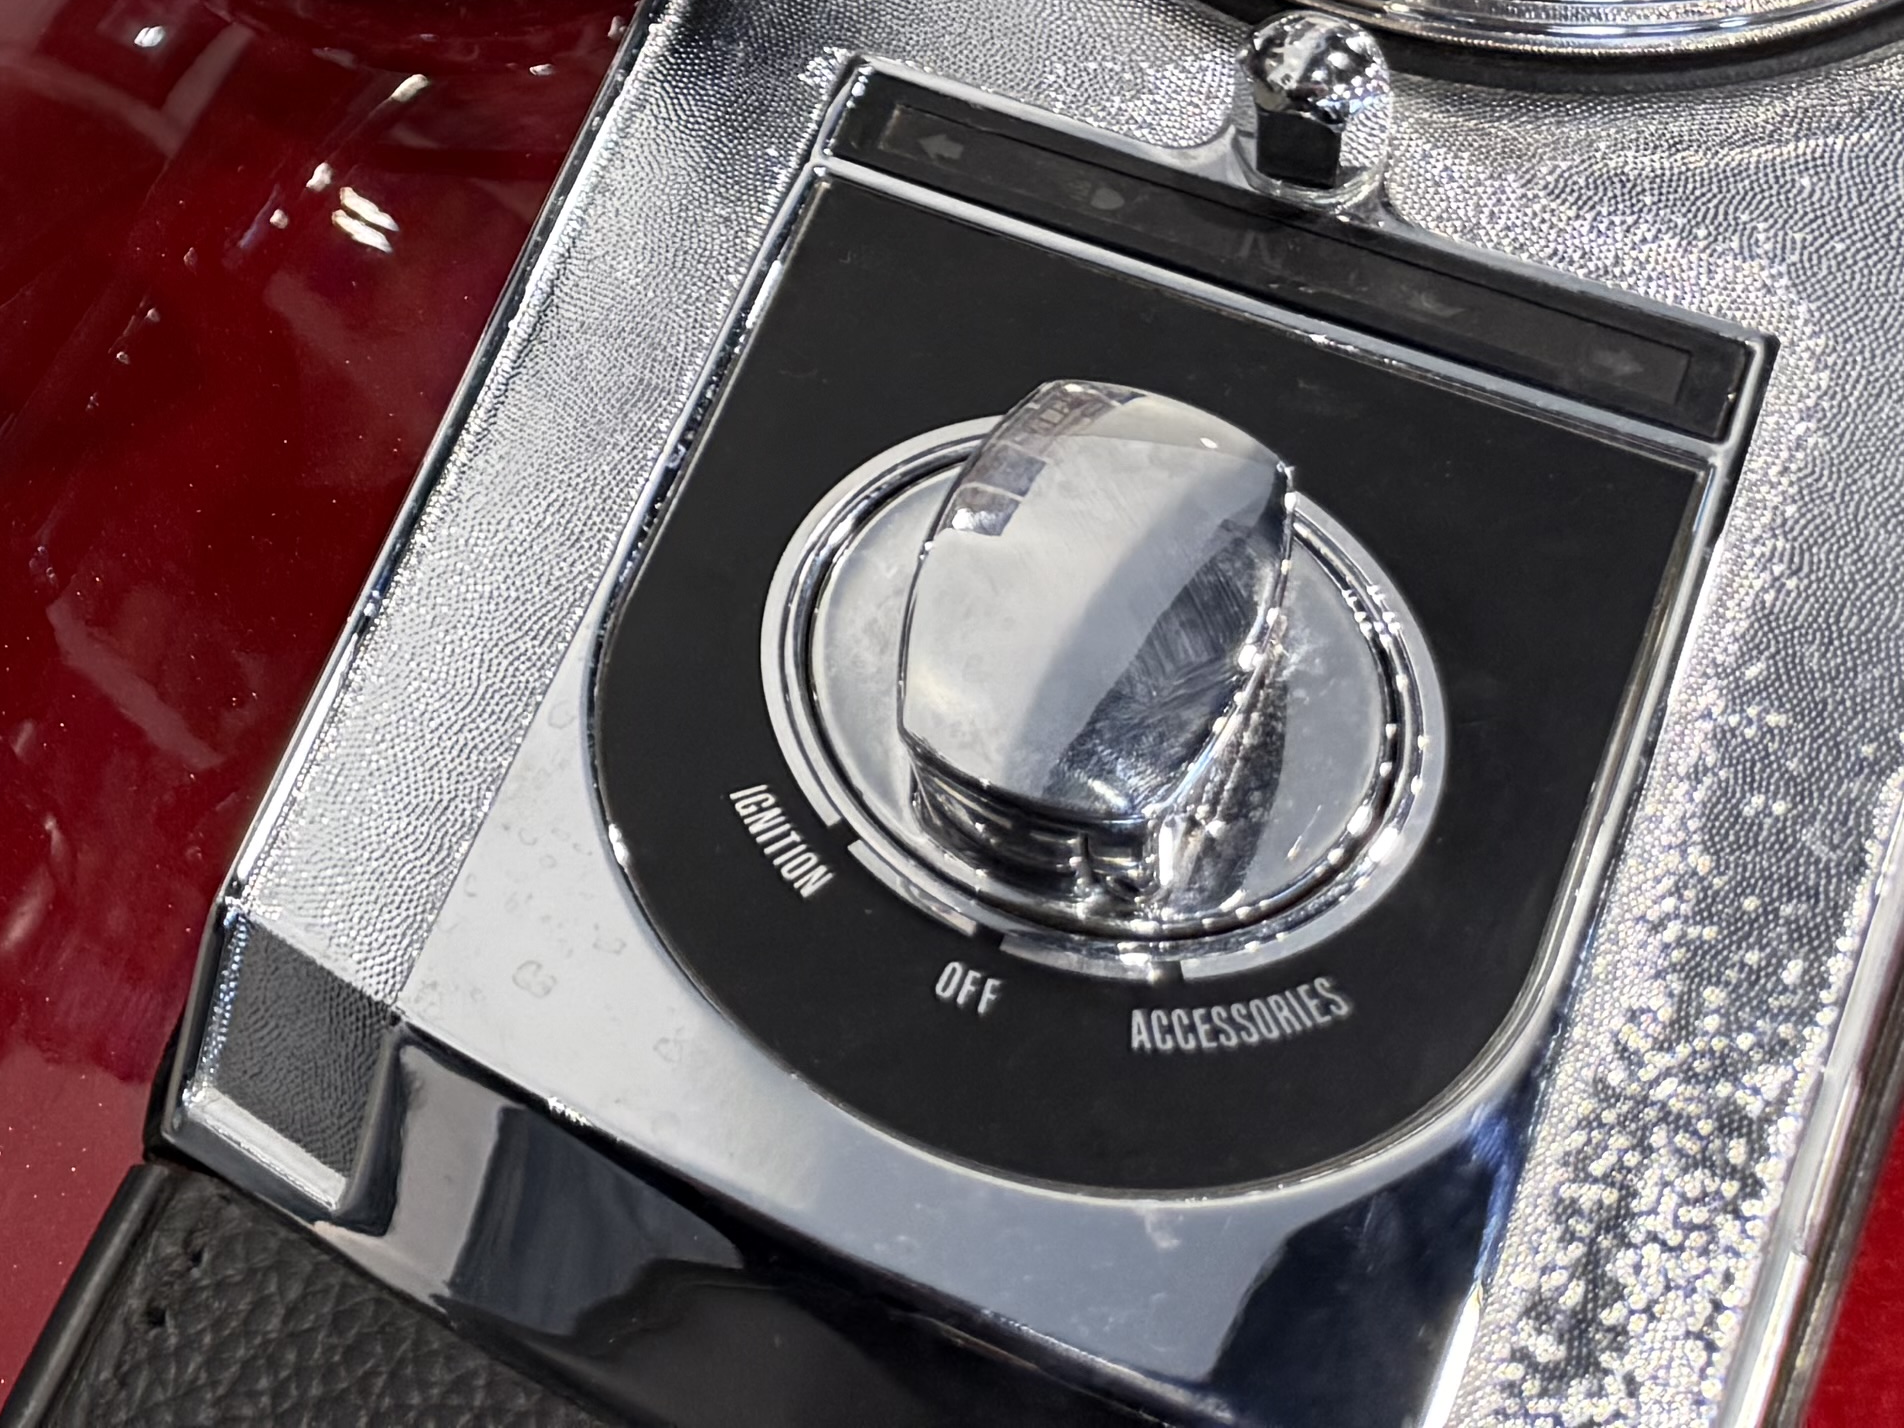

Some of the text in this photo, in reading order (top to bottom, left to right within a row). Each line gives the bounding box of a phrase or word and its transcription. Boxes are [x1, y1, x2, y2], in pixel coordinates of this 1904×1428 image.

[728, 783, 838, 901] IGNITION
[934, 959, 1002, 1016] OFF
[1129, 976, 1353, 1053] ACCESSORIES
